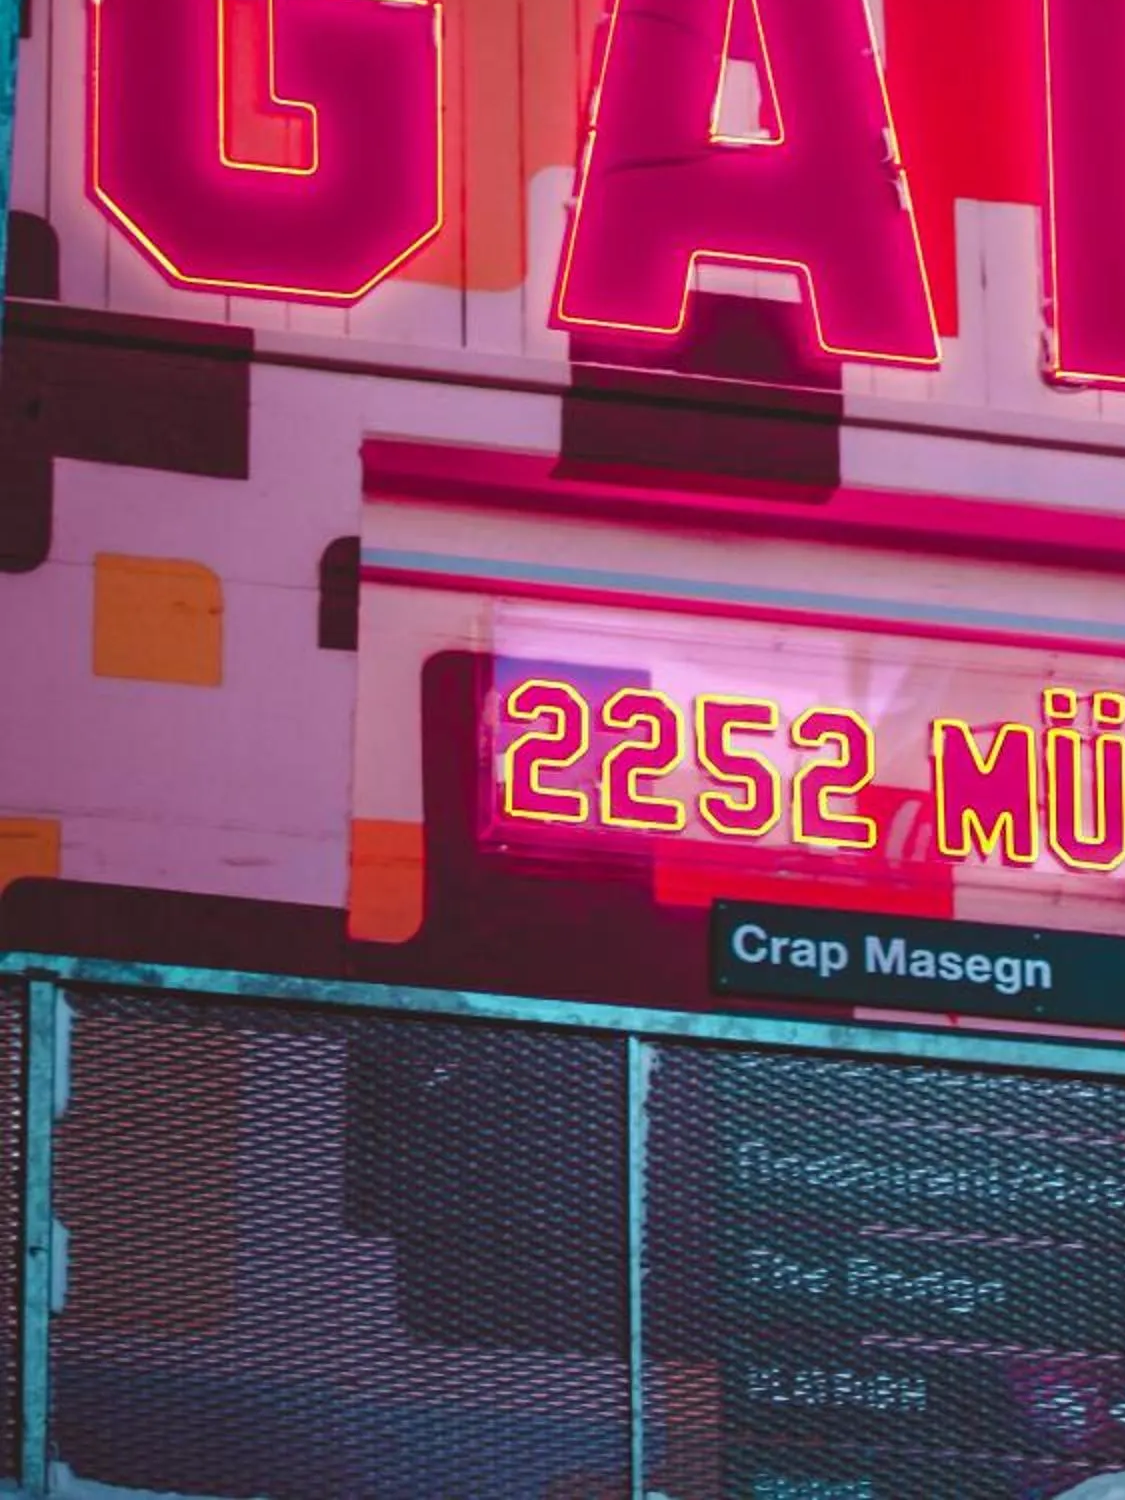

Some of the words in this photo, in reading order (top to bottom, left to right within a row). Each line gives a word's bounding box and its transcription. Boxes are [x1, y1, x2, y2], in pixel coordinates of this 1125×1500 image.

[503, 678, 878, 850] 2252
[731, 923, 850, 974] Crap
[864, 935, 1053, 994] Masegn
